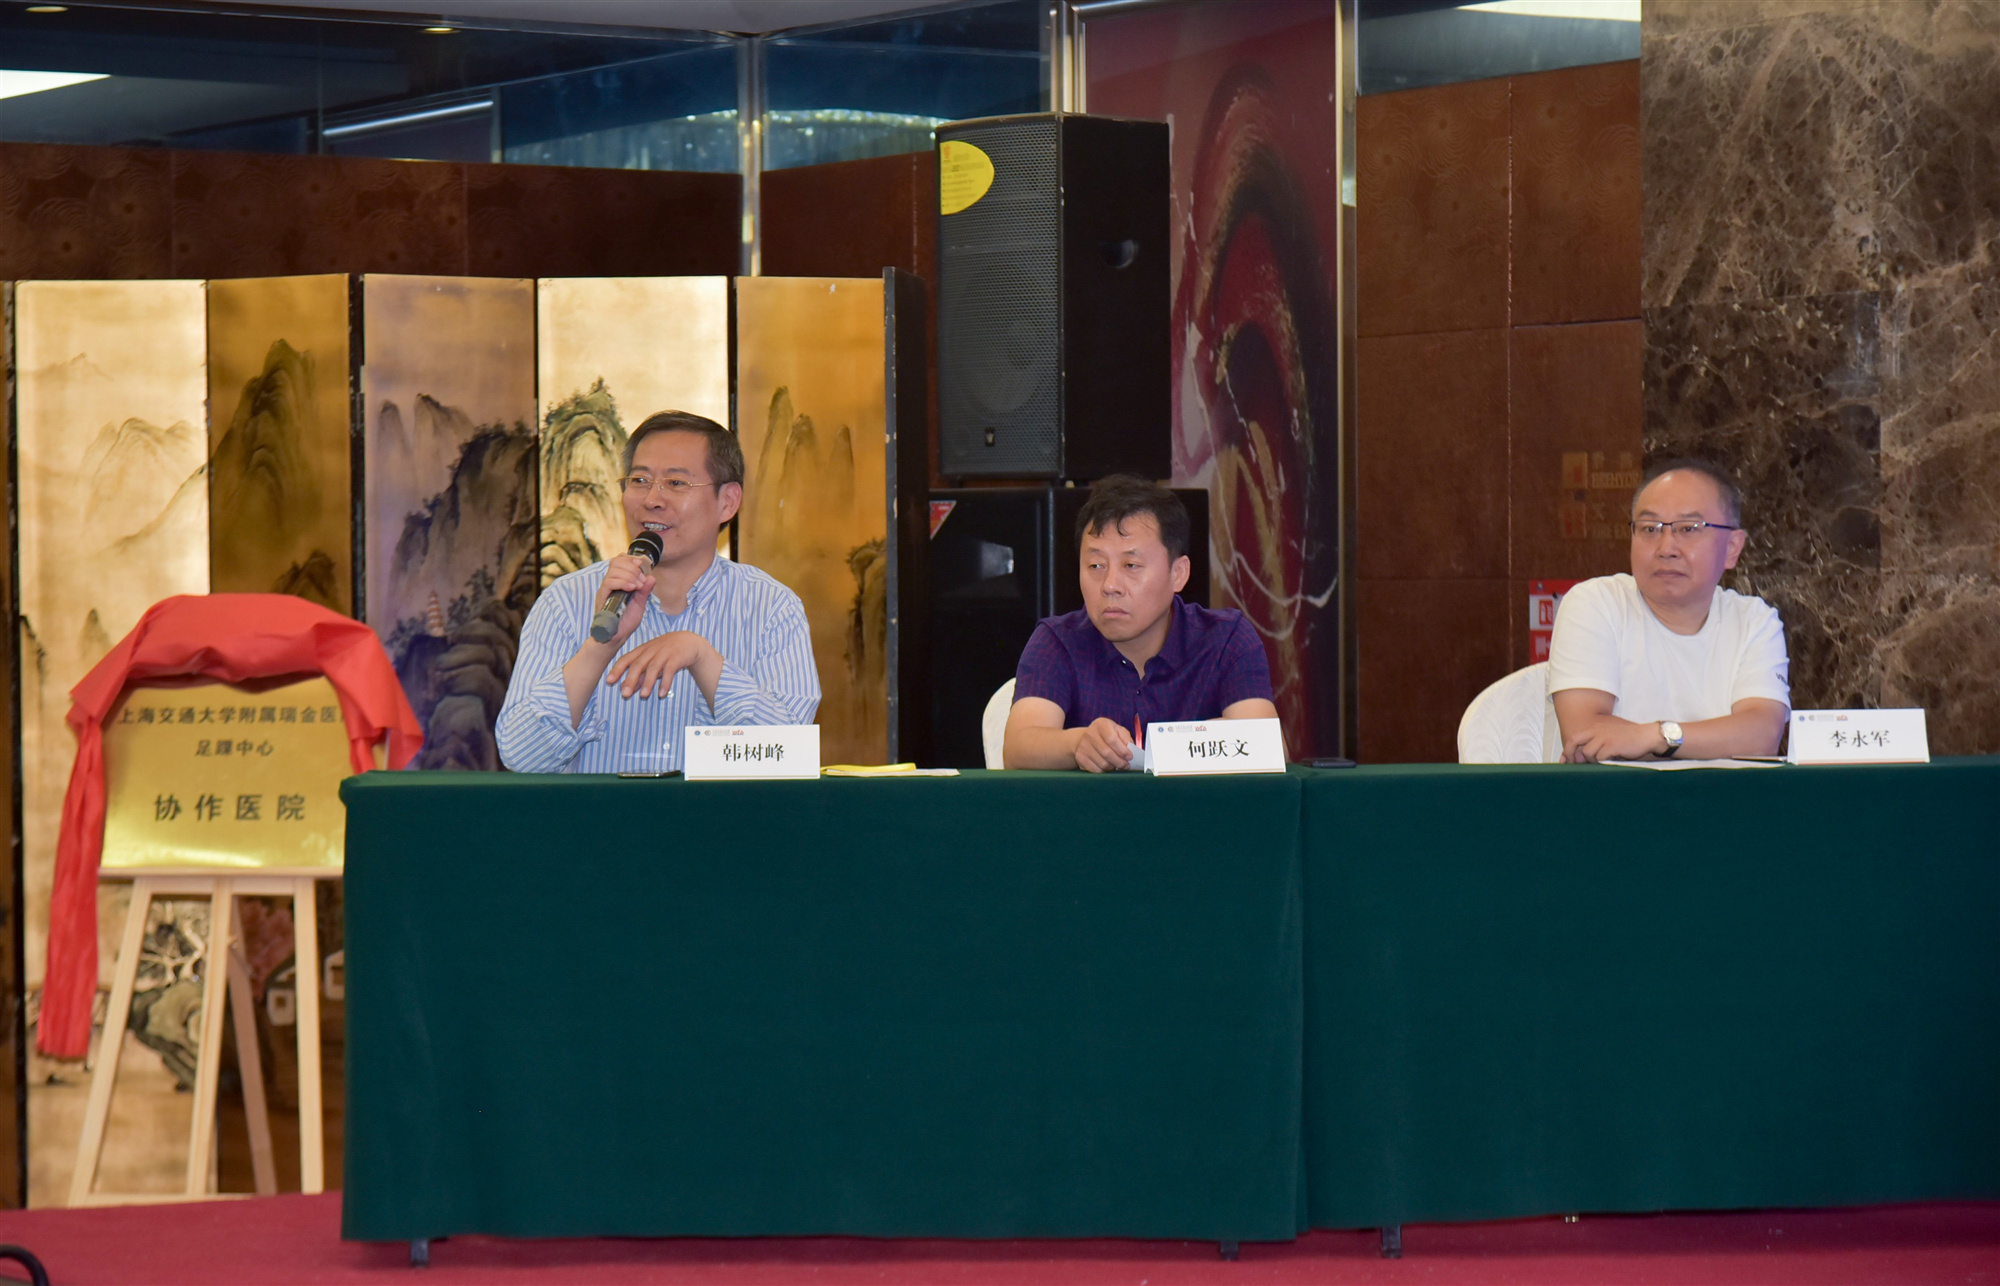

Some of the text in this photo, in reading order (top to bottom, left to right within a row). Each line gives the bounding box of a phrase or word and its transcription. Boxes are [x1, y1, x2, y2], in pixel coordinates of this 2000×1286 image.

[116, 706, 346, 725] 上海交通大学附属瑞金医
[195, 740, 275, 757] 足踝中心
[1187, 739, 1250, 758] 何跃文
[1829, 730, 1890, 748] 李永军
[723, 743, 785, 762] 韩树峰
[154, 794, 307, 822] 协作医院
